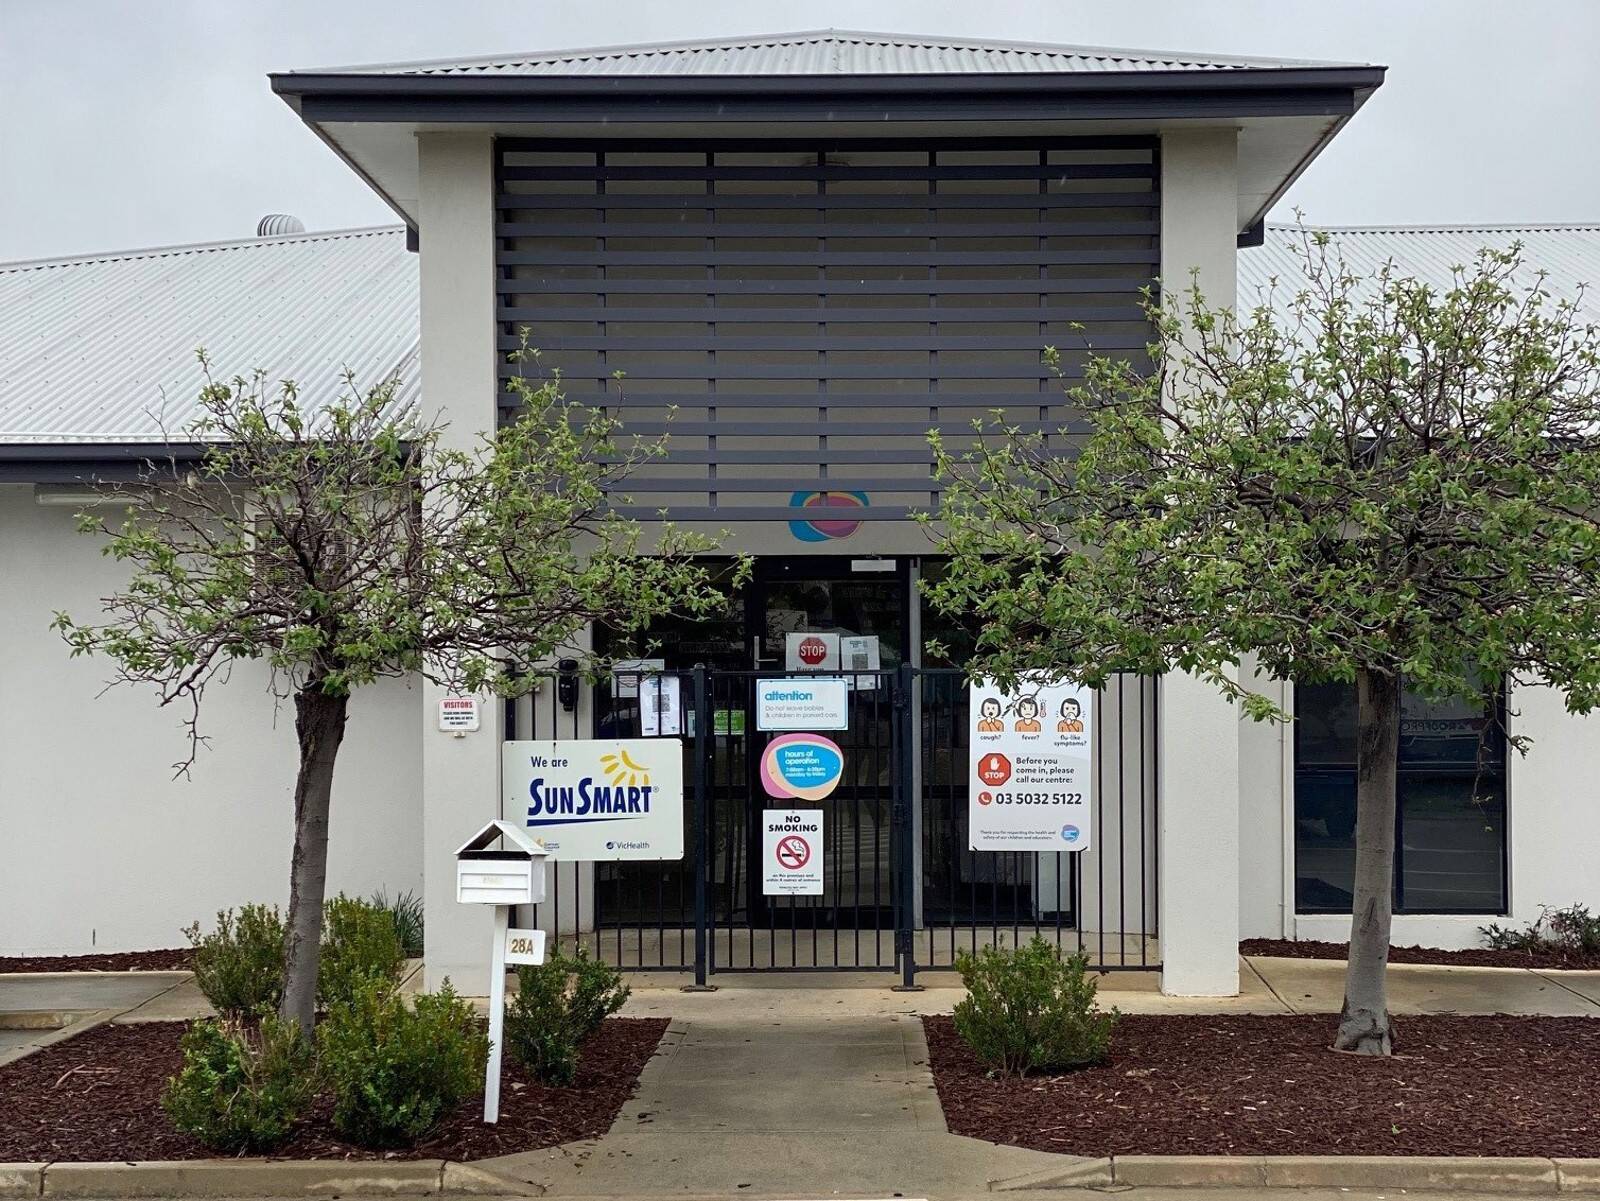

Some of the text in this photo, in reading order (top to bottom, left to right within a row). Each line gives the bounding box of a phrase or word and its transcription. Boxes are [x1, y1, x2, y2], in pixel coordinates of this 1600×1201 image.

[800, 646, 825, 656] STOP
[764, 690, 813, 700] attention
[531, 756, 568, 768] We are
[996, 793, 1082, 804] 03 5032 5122
[616, 841, 650, 849] VicHealth
[511, 938, 534, 954] 28A
